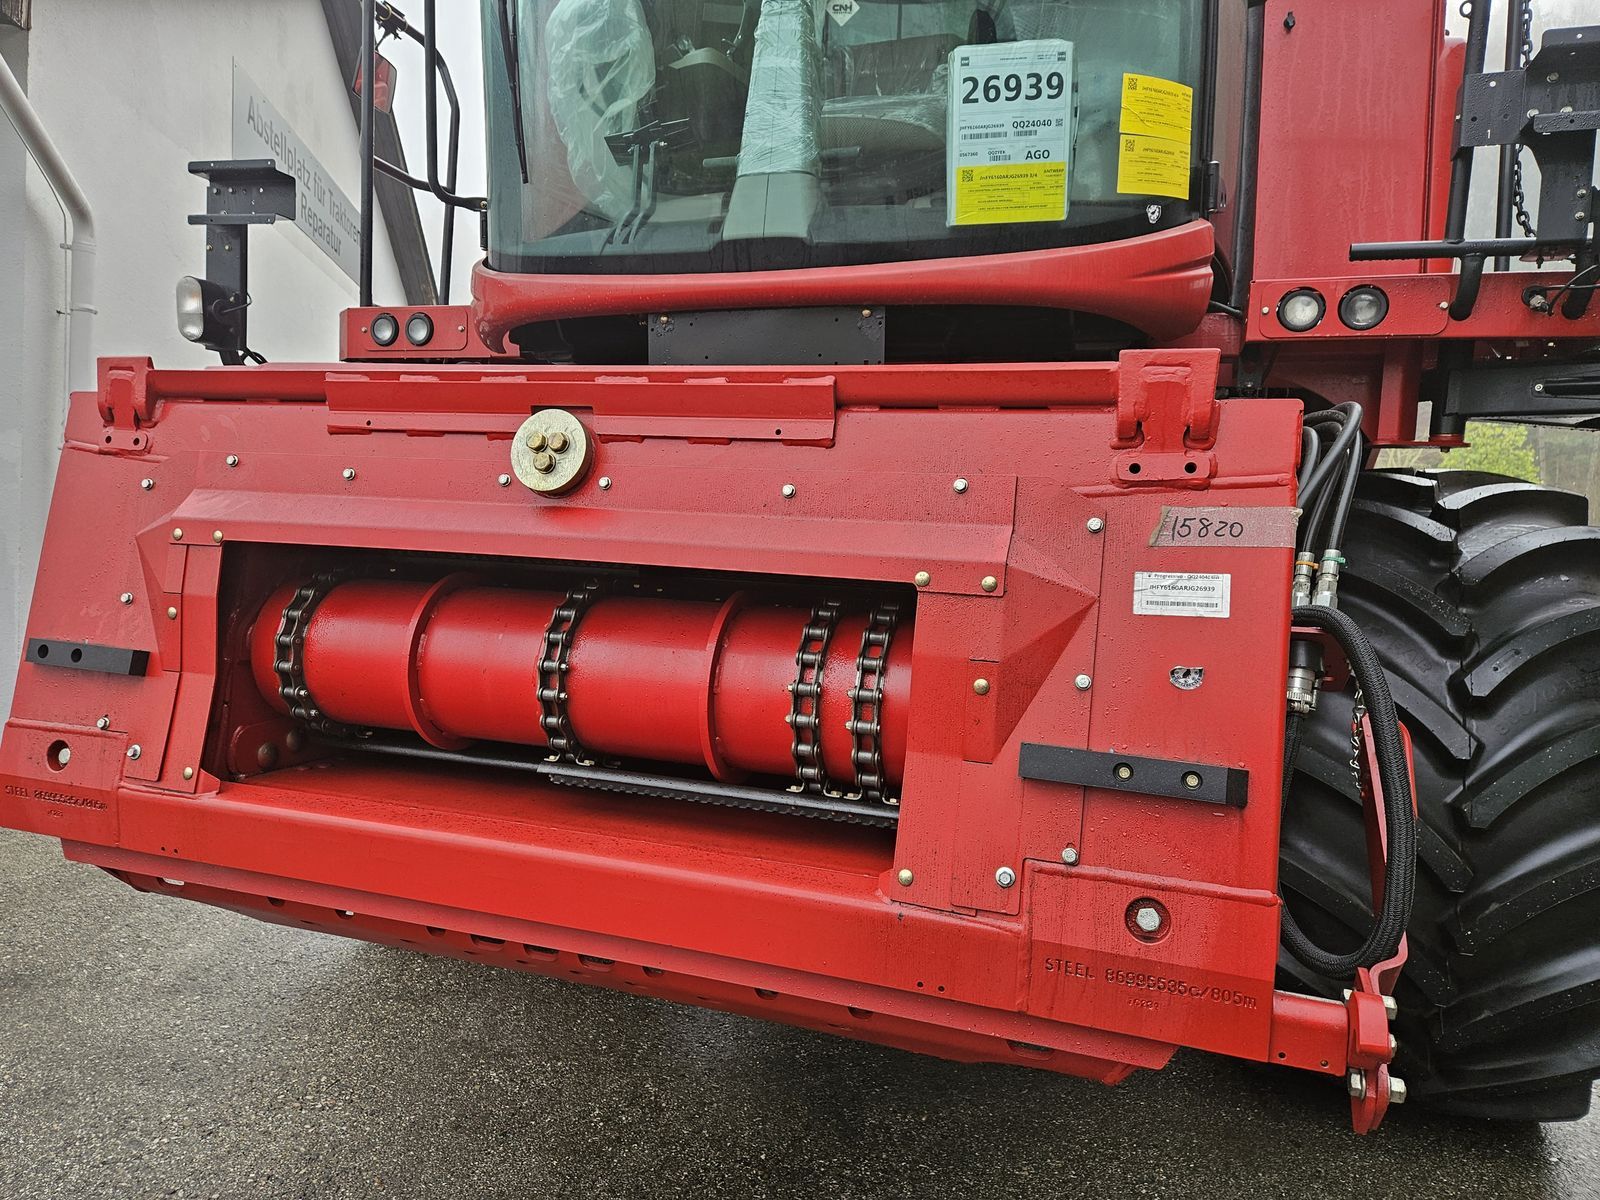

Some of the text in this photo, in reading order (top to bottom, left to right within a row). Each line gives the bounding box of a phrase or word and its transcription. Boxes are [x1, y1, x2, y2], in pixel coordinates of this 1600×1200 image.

[832, 3, 853, 12] CNH
[962, 71, 1064, 104] 26939
[1012, 118, 1052, 129] QQ24040
[247, 95, 311, 191] Abstellplatz
[313, 170, 326, 205] für
[1025, 149, 1051, 160] AGO
[300, 191, 342, 257] Reparatur
[1171, 515, 1244, 541] 15820
[1044, 957, 1096, 980] STEEL
